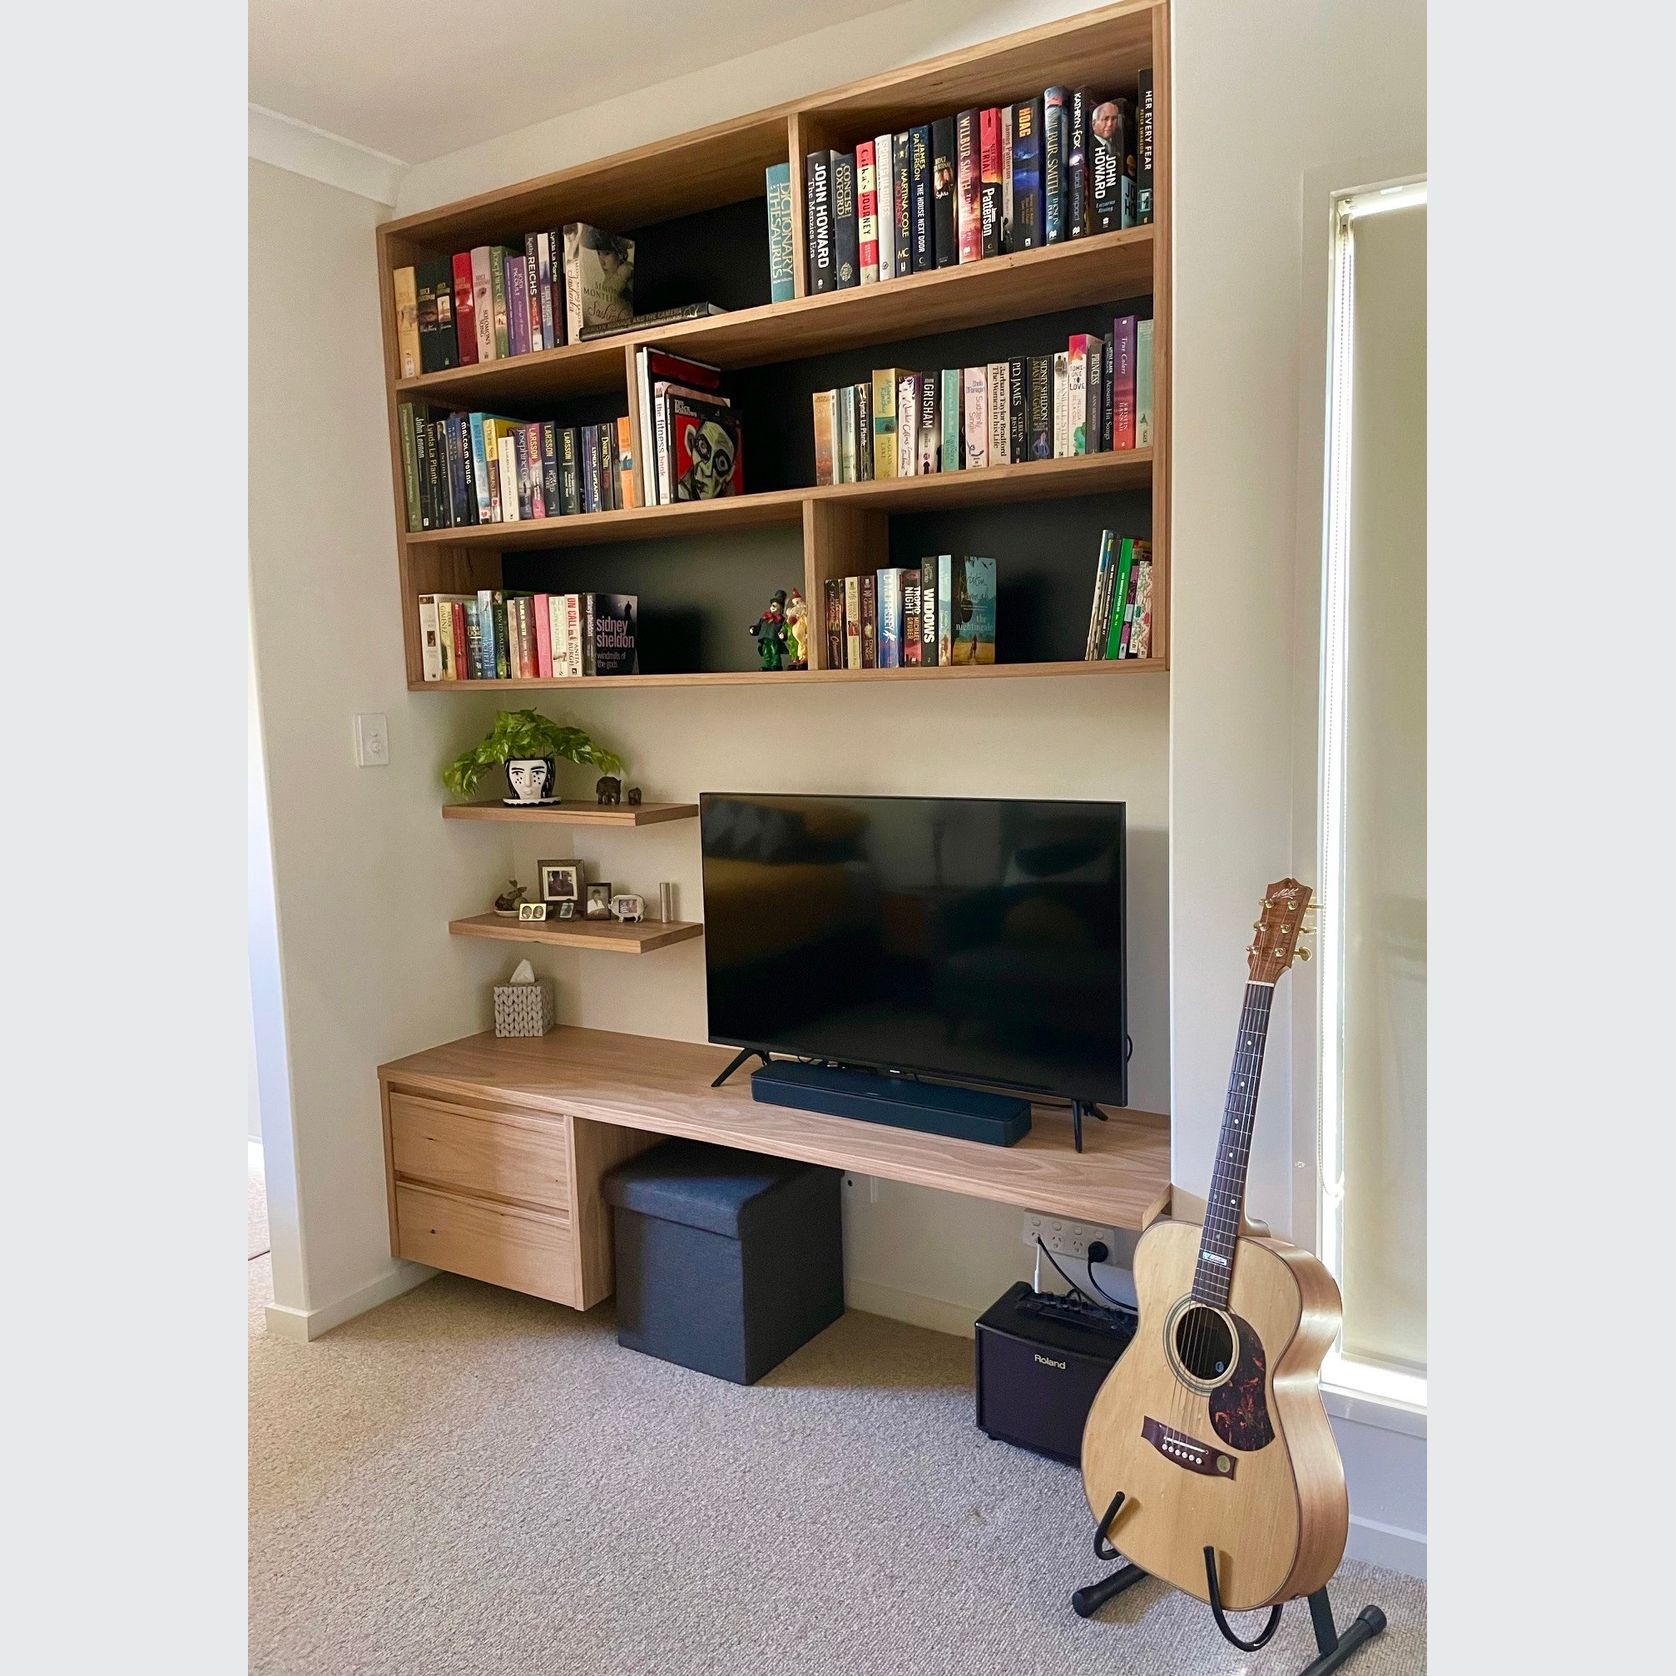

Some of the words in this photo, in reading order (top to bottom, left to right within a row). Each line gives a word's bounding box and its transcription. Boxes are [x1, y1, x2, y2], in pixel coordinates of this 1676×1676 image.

[1073, 92, 1082, 128] KATHRYN
[1145, 91, 1153, 109] HER
[959, 116, 970, 158] WILBUR
[1019, 107, 1031, 137] HOAG
[1047, 112, 1059, 158] WILBUR
[1144, 112, 1152, 143] EVERY
[1072, 130, 1083, 149] fox
[860, 149, 870, 190] Cilka's
[880, 141, 889, 176] SPORTS
[913, 133, 921, 180] PATTERSON
[982, 149, 991, 173] TRIAL
[1105, 155, 1117, 187] JOHN
[1144, 146, 1152, 170] FEAR
[814, 163, 827, 202] JOHN
[960, 160, 971, 190] SMITH
[1046, 159, 1059, 195] SMITH
[1094, 146, 1107, 199] HOWARD
[835, 167, 845, 216] OXFORD
[843, 165, 852, 214] CONCISE
[901, 168, 909, 209] MARTINA
[862, 193, 872, 235] JOURNEY
[982, 188, 995, 236] Patterson
[1072, 192, 1082, 221] impact
[769, 189, 782, 279] THESAURUS
[780, 183, 793, 274] DICTIONARY
[816, 205, 829, 268] HOWARD
[902, 211, 910, 238] COLE
[491, 250, 505, 292] Josephine
[528, 256, 538, 295] REICHS
[992, 366, 1000, 381] The
[1032, 360, 1040, 391] MASTER
[1040, 360, 1048, 385] SIDNEY
[1091, 354, 1100, 385] PRINCESS
[1010, 378, 1022, 406] JAMES
[1070, 383, 1085, 391] LOVE
[1105, 380, 1113, 407] Acoustic
[923, 384, 935, 429] GRISHAM
[993, 412, 1000, 420] in
[999, 398, 1007, 421] Taylor
[1032, 398, 1041, 422] GAME
[1041, 387, 1049, 421] SHELDON
[1105, 409, 1113, 421] Hit
[416, 417, 425, 433] John
[427, 424, 435, 447] Lynda
[657, 419, 665, 454] fitness
[1104, 422, 1112, 441] Songs
[417, 435, 426, 459] Lennon
[429, 448, 436, 458] La
[517, 429, 529, 467] Josephine
[528, 427, 538, 459] LARSSON
[544, 425, 554, 457] LARSSON
[564, 432, 573, 459] LARSSON
[430, 460, 438, 485] Plante
[567, 597, 576, 608] ON
[905, 586, 914, 615] NIGHT
[923, 588, 935, 643] WIDOWS
[440, 605, 448, 634] GIMENEZ
[568, 610, 577, 628] CALL
[596, 616, 629, 635] sidney
[596, 631, 635, 649] sheldon
[1034, 1354, 1066, 1370] Roland
